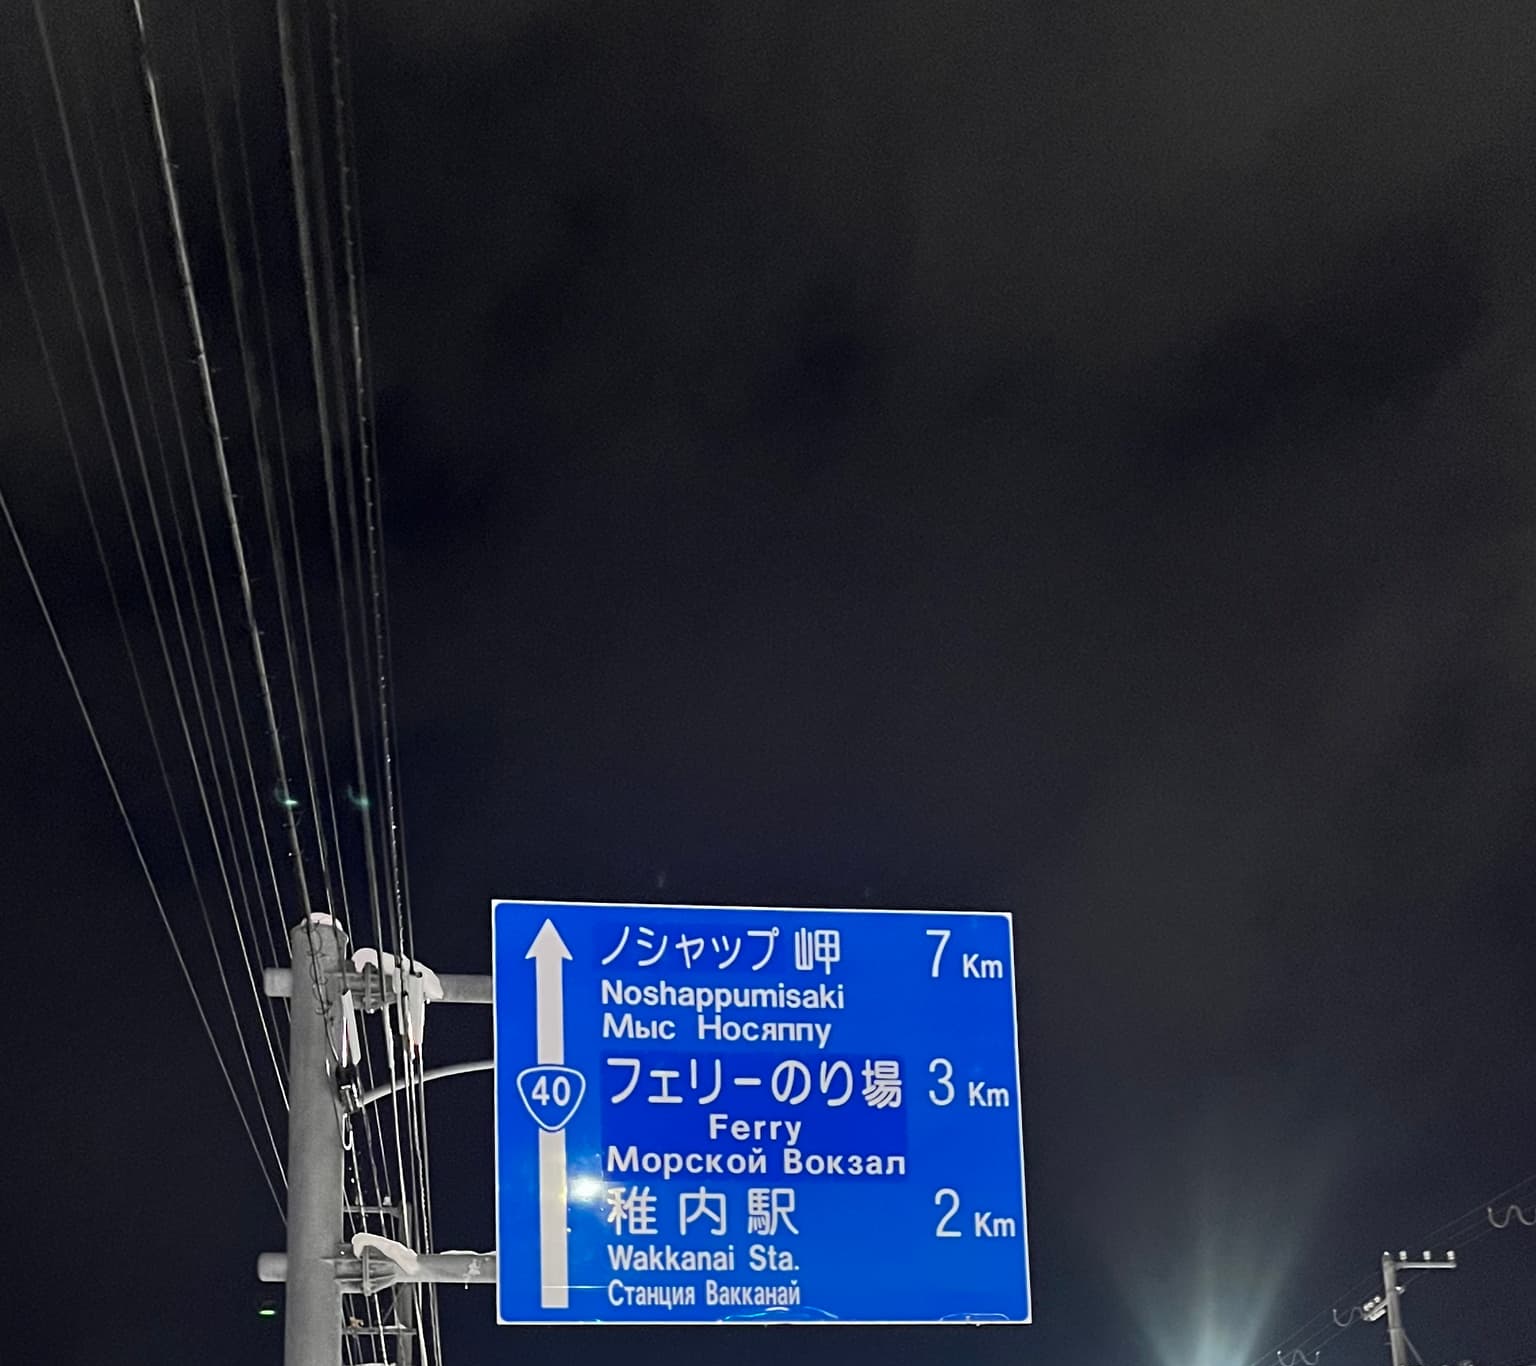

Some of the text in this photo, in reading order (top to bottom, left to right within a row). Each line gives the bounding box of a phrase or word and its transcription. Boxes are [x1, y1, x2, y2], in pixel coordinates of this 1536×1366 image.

[926, 929, 1003, 979] 7 Km
[601, 979, 844, 1012] Noshappumisaki
[603, 1013, 832, 1049] Мыс Носяппу
[531, 1076, 571, 1107] 40
[607, 1057, 902, 1109] フェリーのり場
[929, 1058, 1009, 1107] 3 Km
[709, 1113, 802, 1146] Ferry
[607, 1145, 906, 1180] Морской Вокзал
[607, 1186, 799, 1236] 稚内駅
[934, 1188, 1016, 1237] 2 Km
[607, 1244, 800, 1272] Wakkanai Sta.
[607, 1278, 801, 1309] Станция Вакканай
